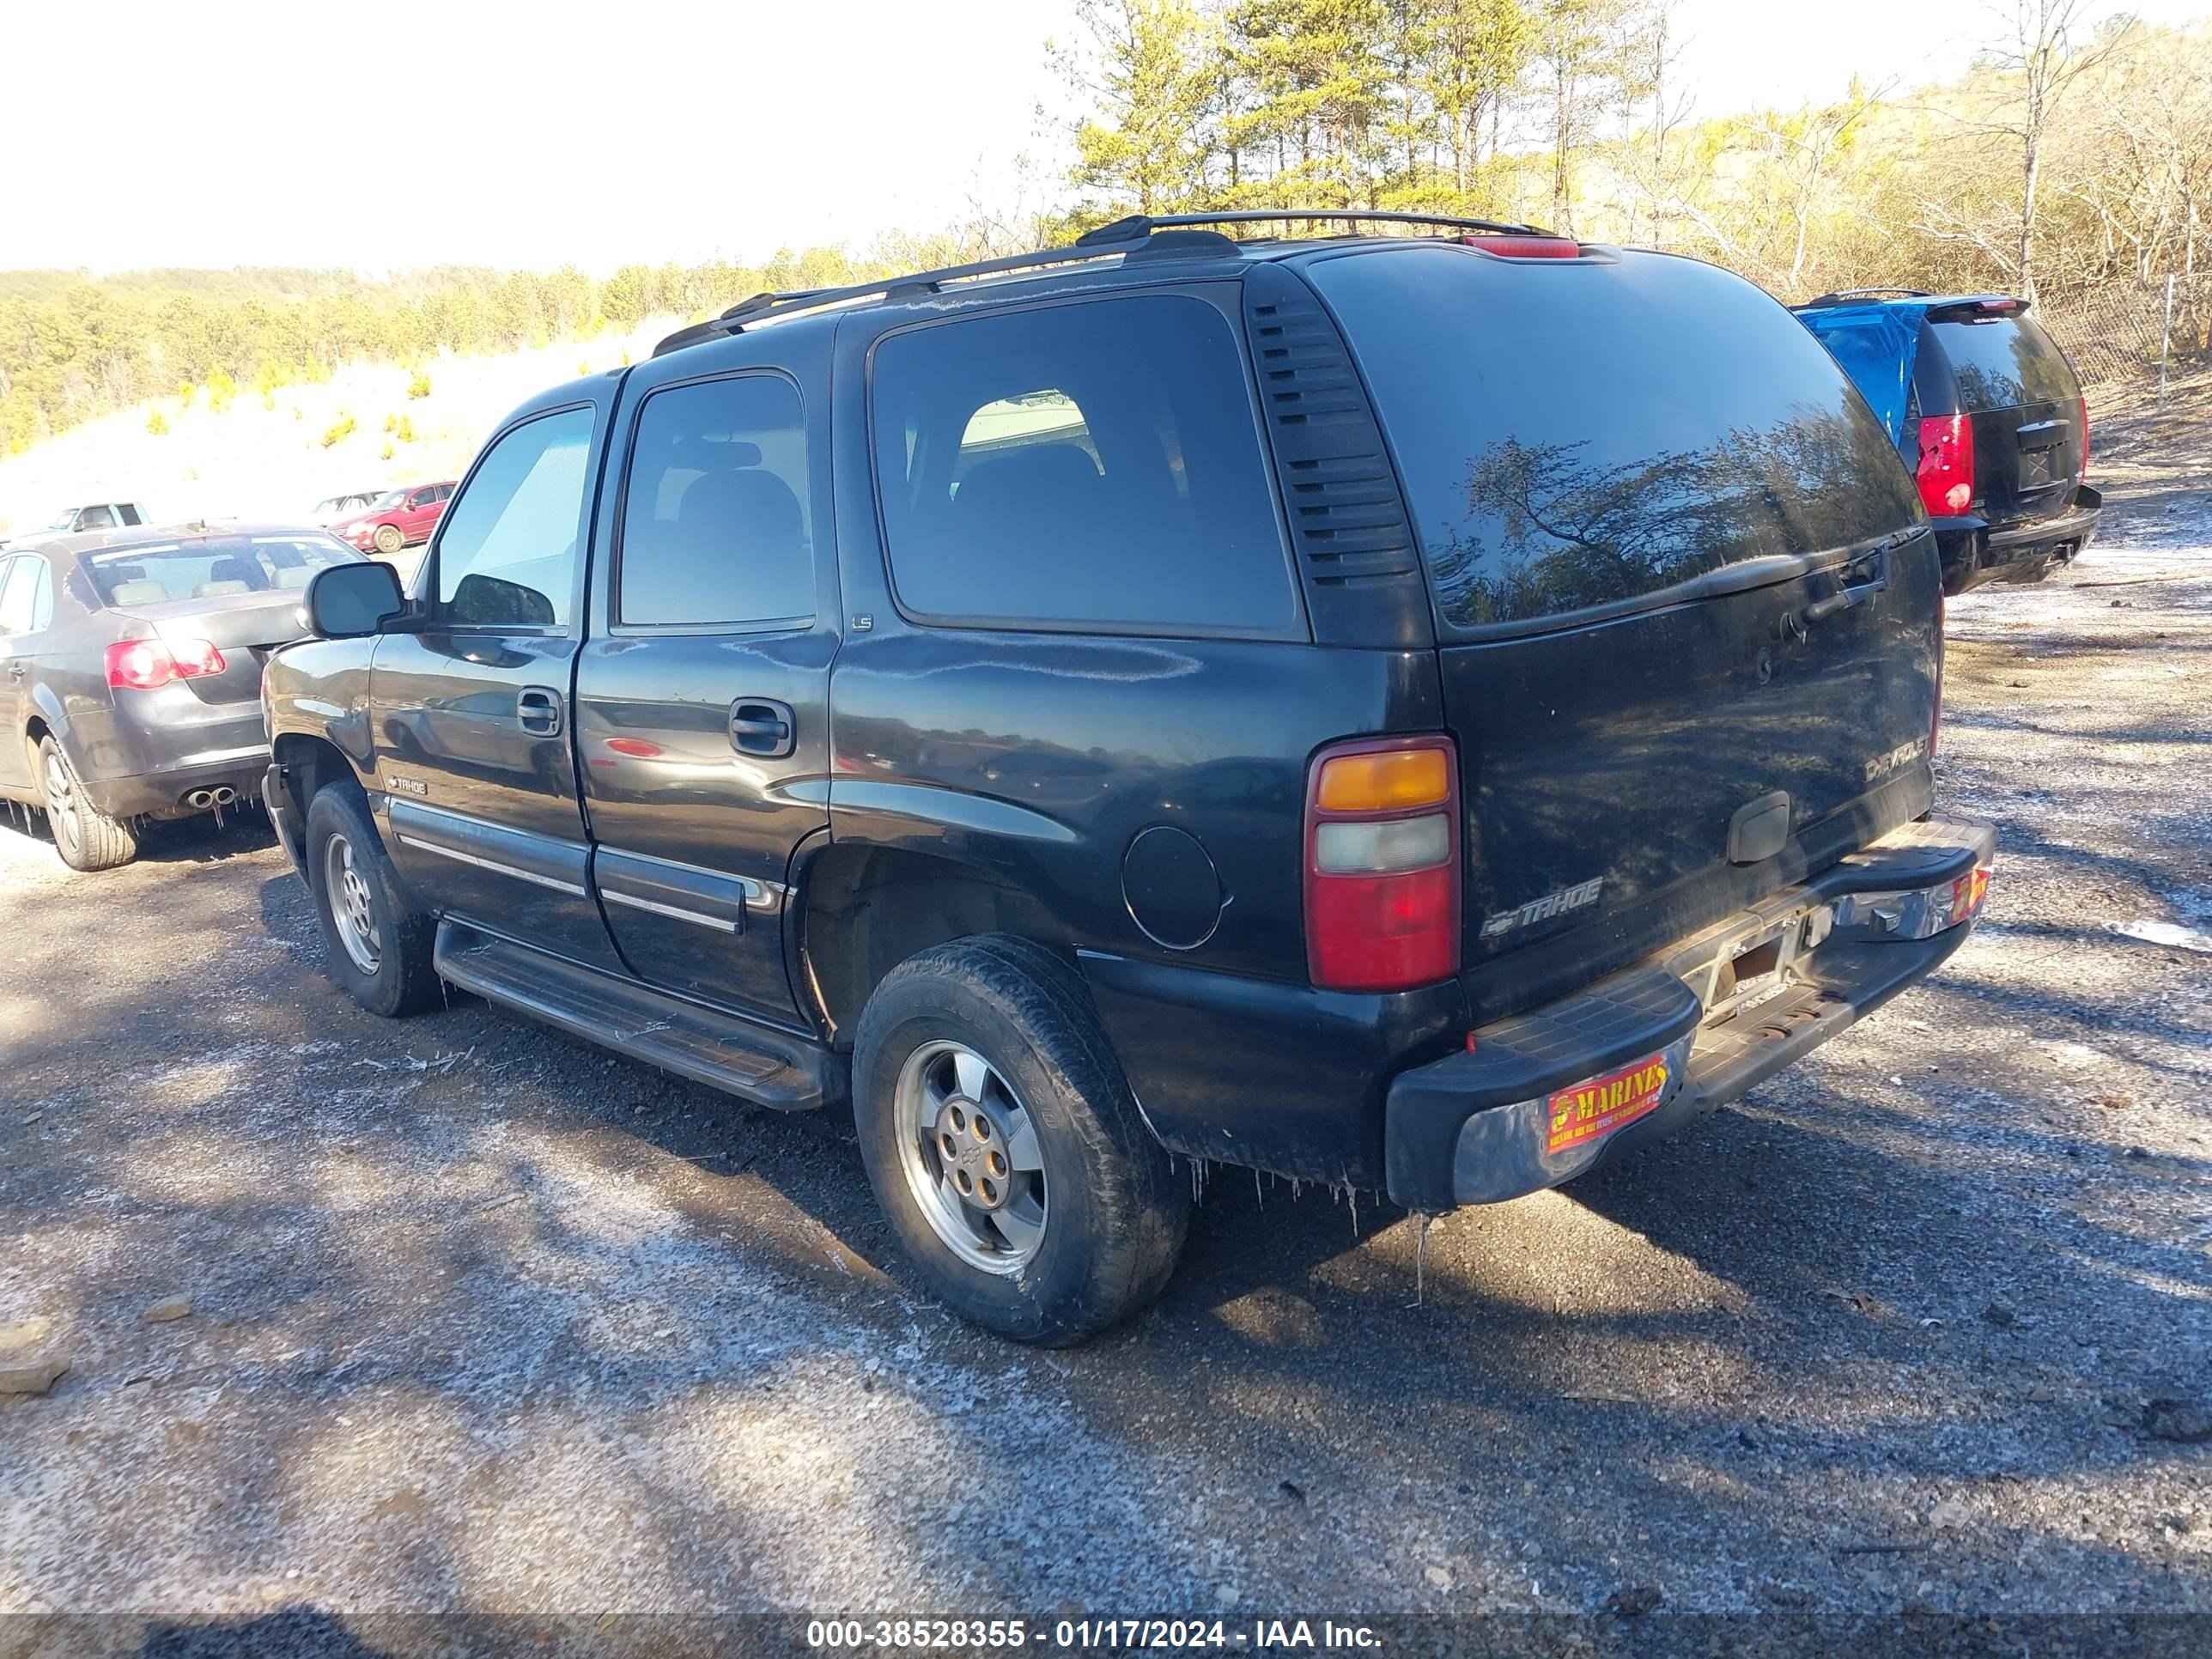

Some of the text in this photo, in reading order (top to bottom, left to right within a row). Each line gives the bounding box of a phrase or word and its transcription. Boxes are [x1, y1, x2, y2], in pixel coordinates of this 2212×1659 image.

[851, 617, 872, 629] LS
[397, 779, 426, 794] TAHOE
[1522, 878, 1603, 927] TAHOE
